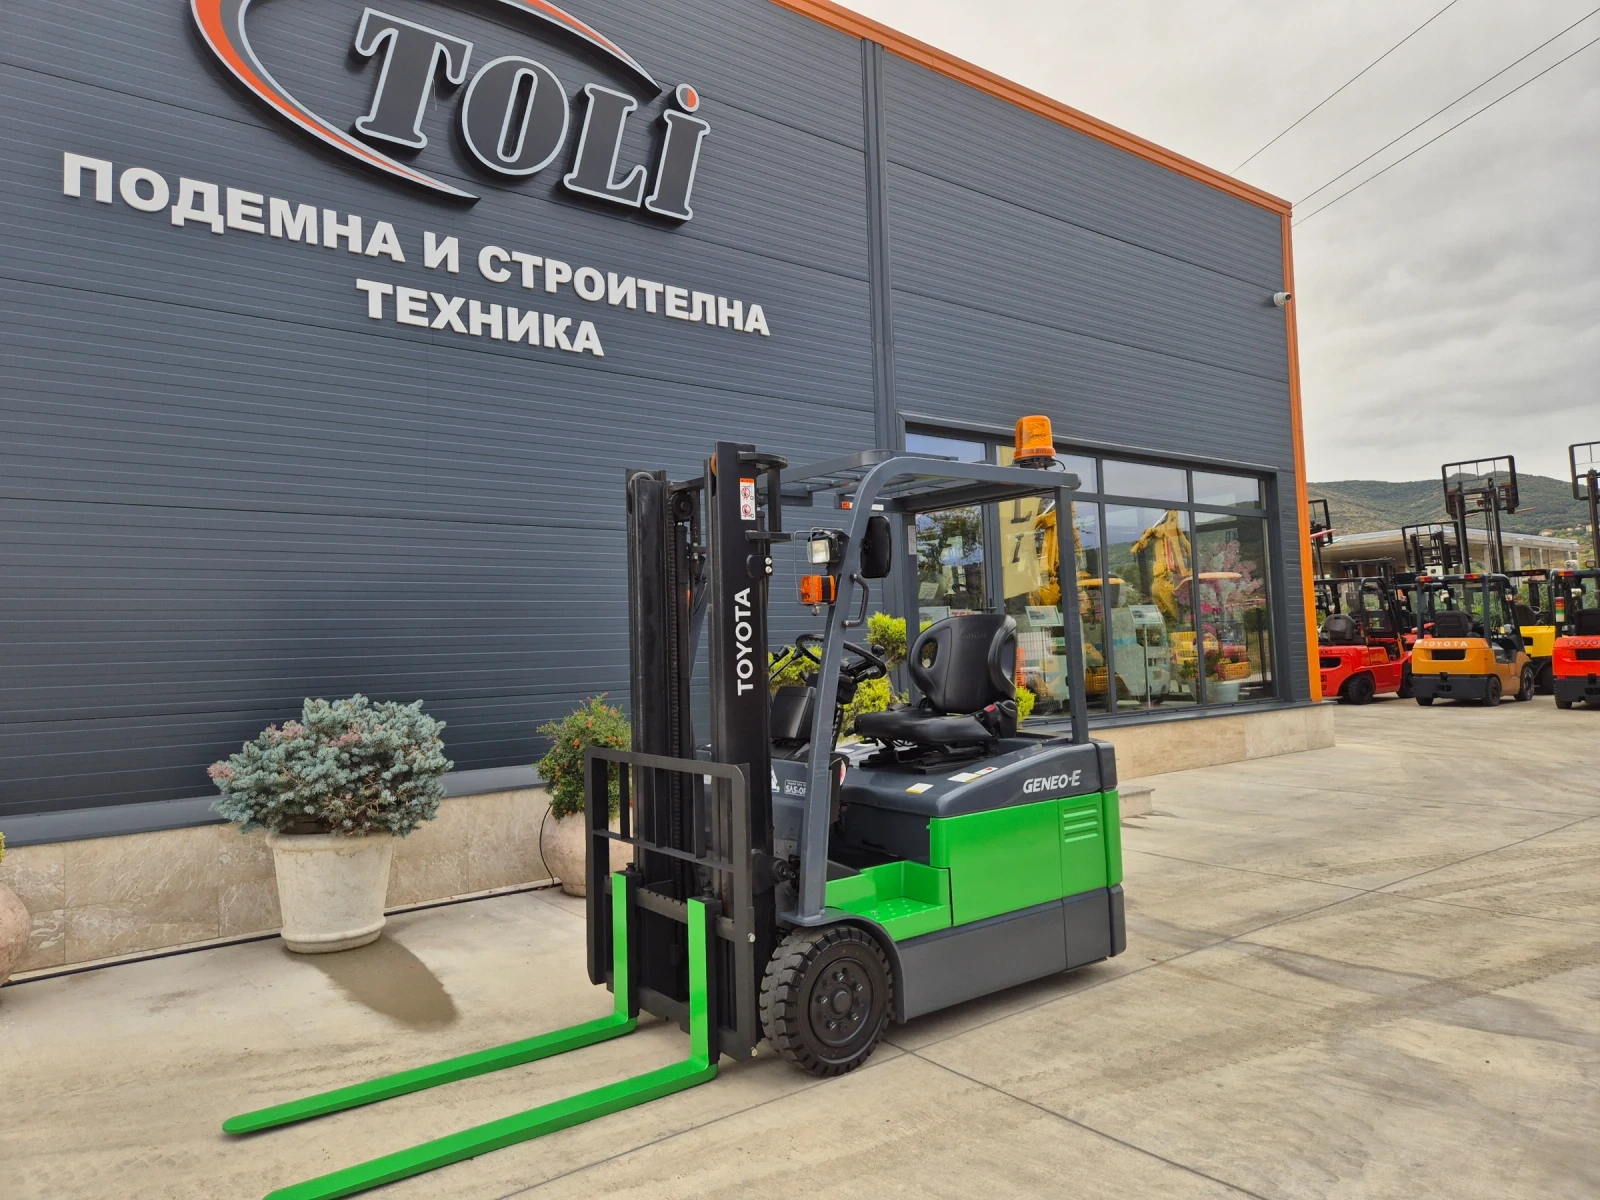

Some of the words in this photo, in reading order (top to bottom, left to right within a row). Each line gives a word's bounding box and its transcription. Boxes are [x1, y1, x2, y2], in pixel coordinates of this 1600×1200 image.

[63, 151, 406, 263] ПОДЕМНА
[423, 231, 460, 273] И
[478, 245, 771, 336] СТРОИТЕЛНА
[356, 279, 605, 357] ТЕХНИКА
[734, 587, 754, 696] TOYOTA
